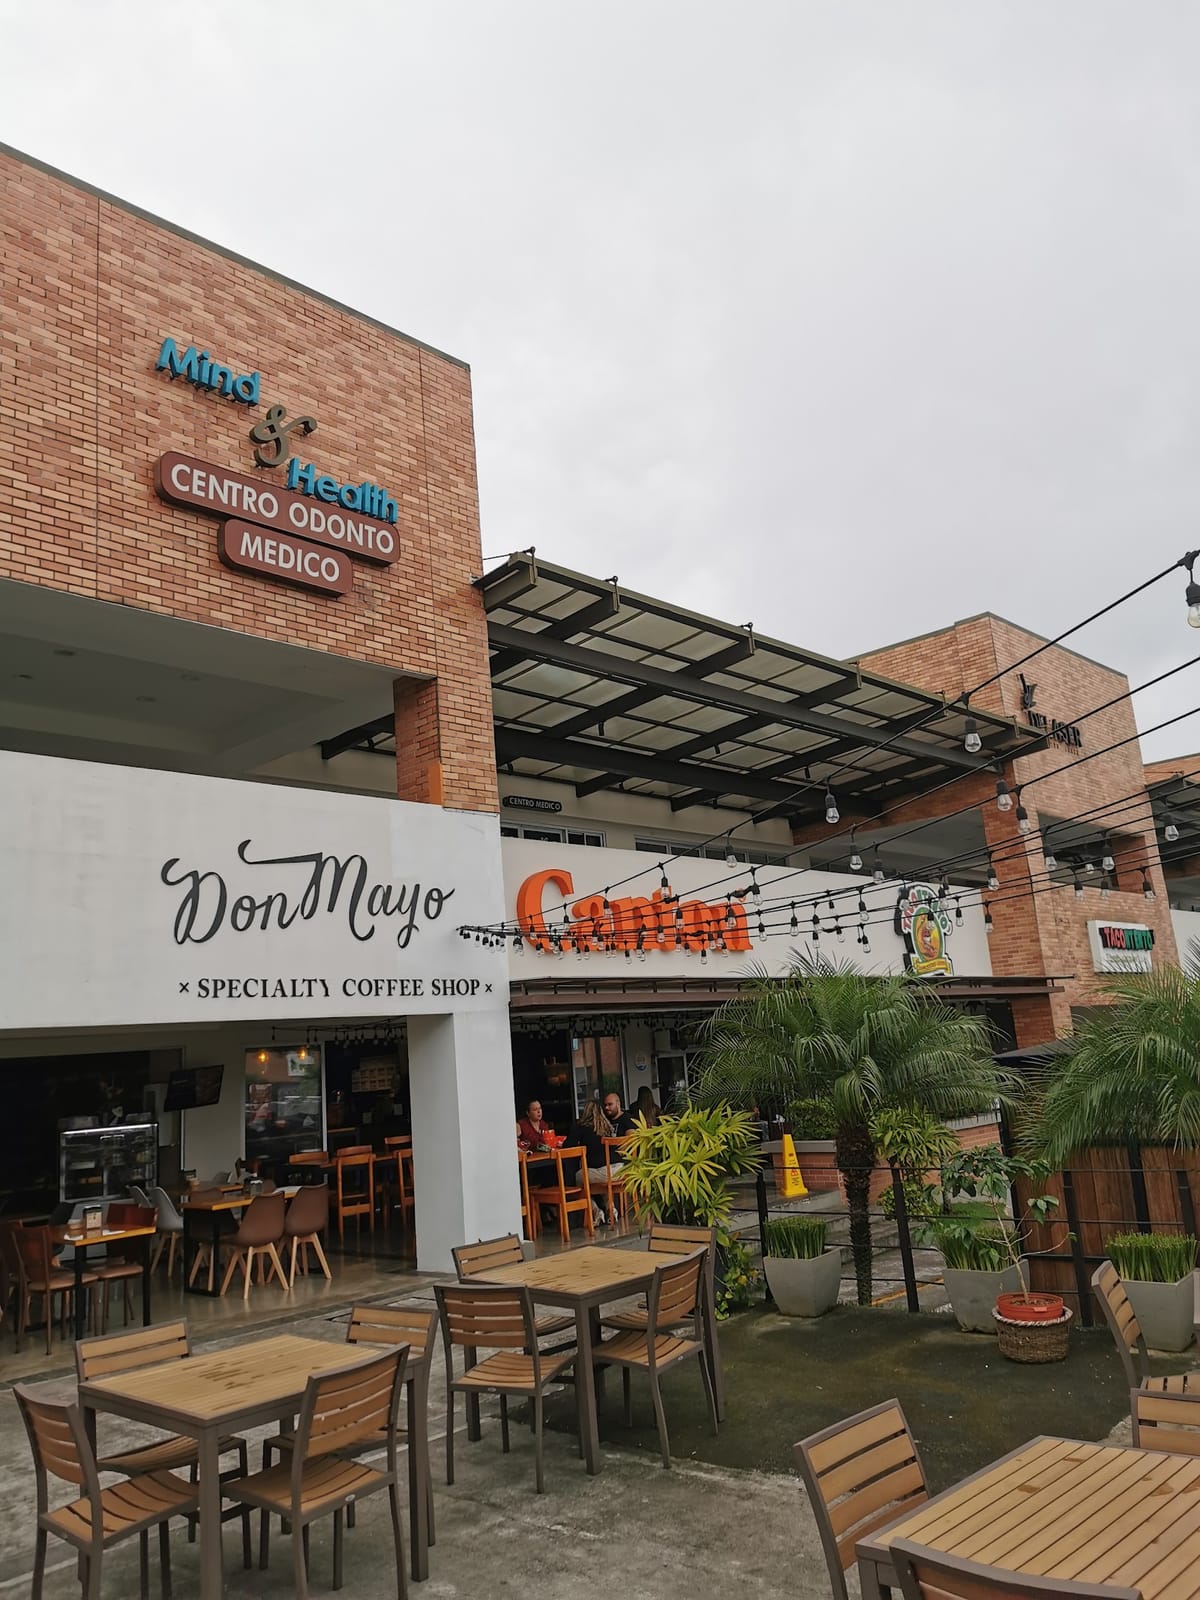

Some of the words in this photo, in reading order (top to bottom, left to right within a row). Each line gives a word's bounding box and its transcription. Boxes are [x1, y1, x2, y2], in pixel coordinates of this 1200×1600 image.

[156, 338, 261, 406] Mind
[250, 404, 317, 467] &
[171, 464, 279, 519] CENTRO
[289, 502, 394, 553] ODONTO
[287, 458, 398, 523] Health
[240, 532, 340, 582] MEDICO
[509, 797, 534, 807] CENTRO
[535, 801, 560, 811] MEDICO
[160, 858, 300, 945] Don
[238, 839, 455, 949] Mayo
[197, 978, 330, 998] SPECIALTY
[342, 978, 424, 997] COFFEE
[431, 980, 480, 996] SHOP
